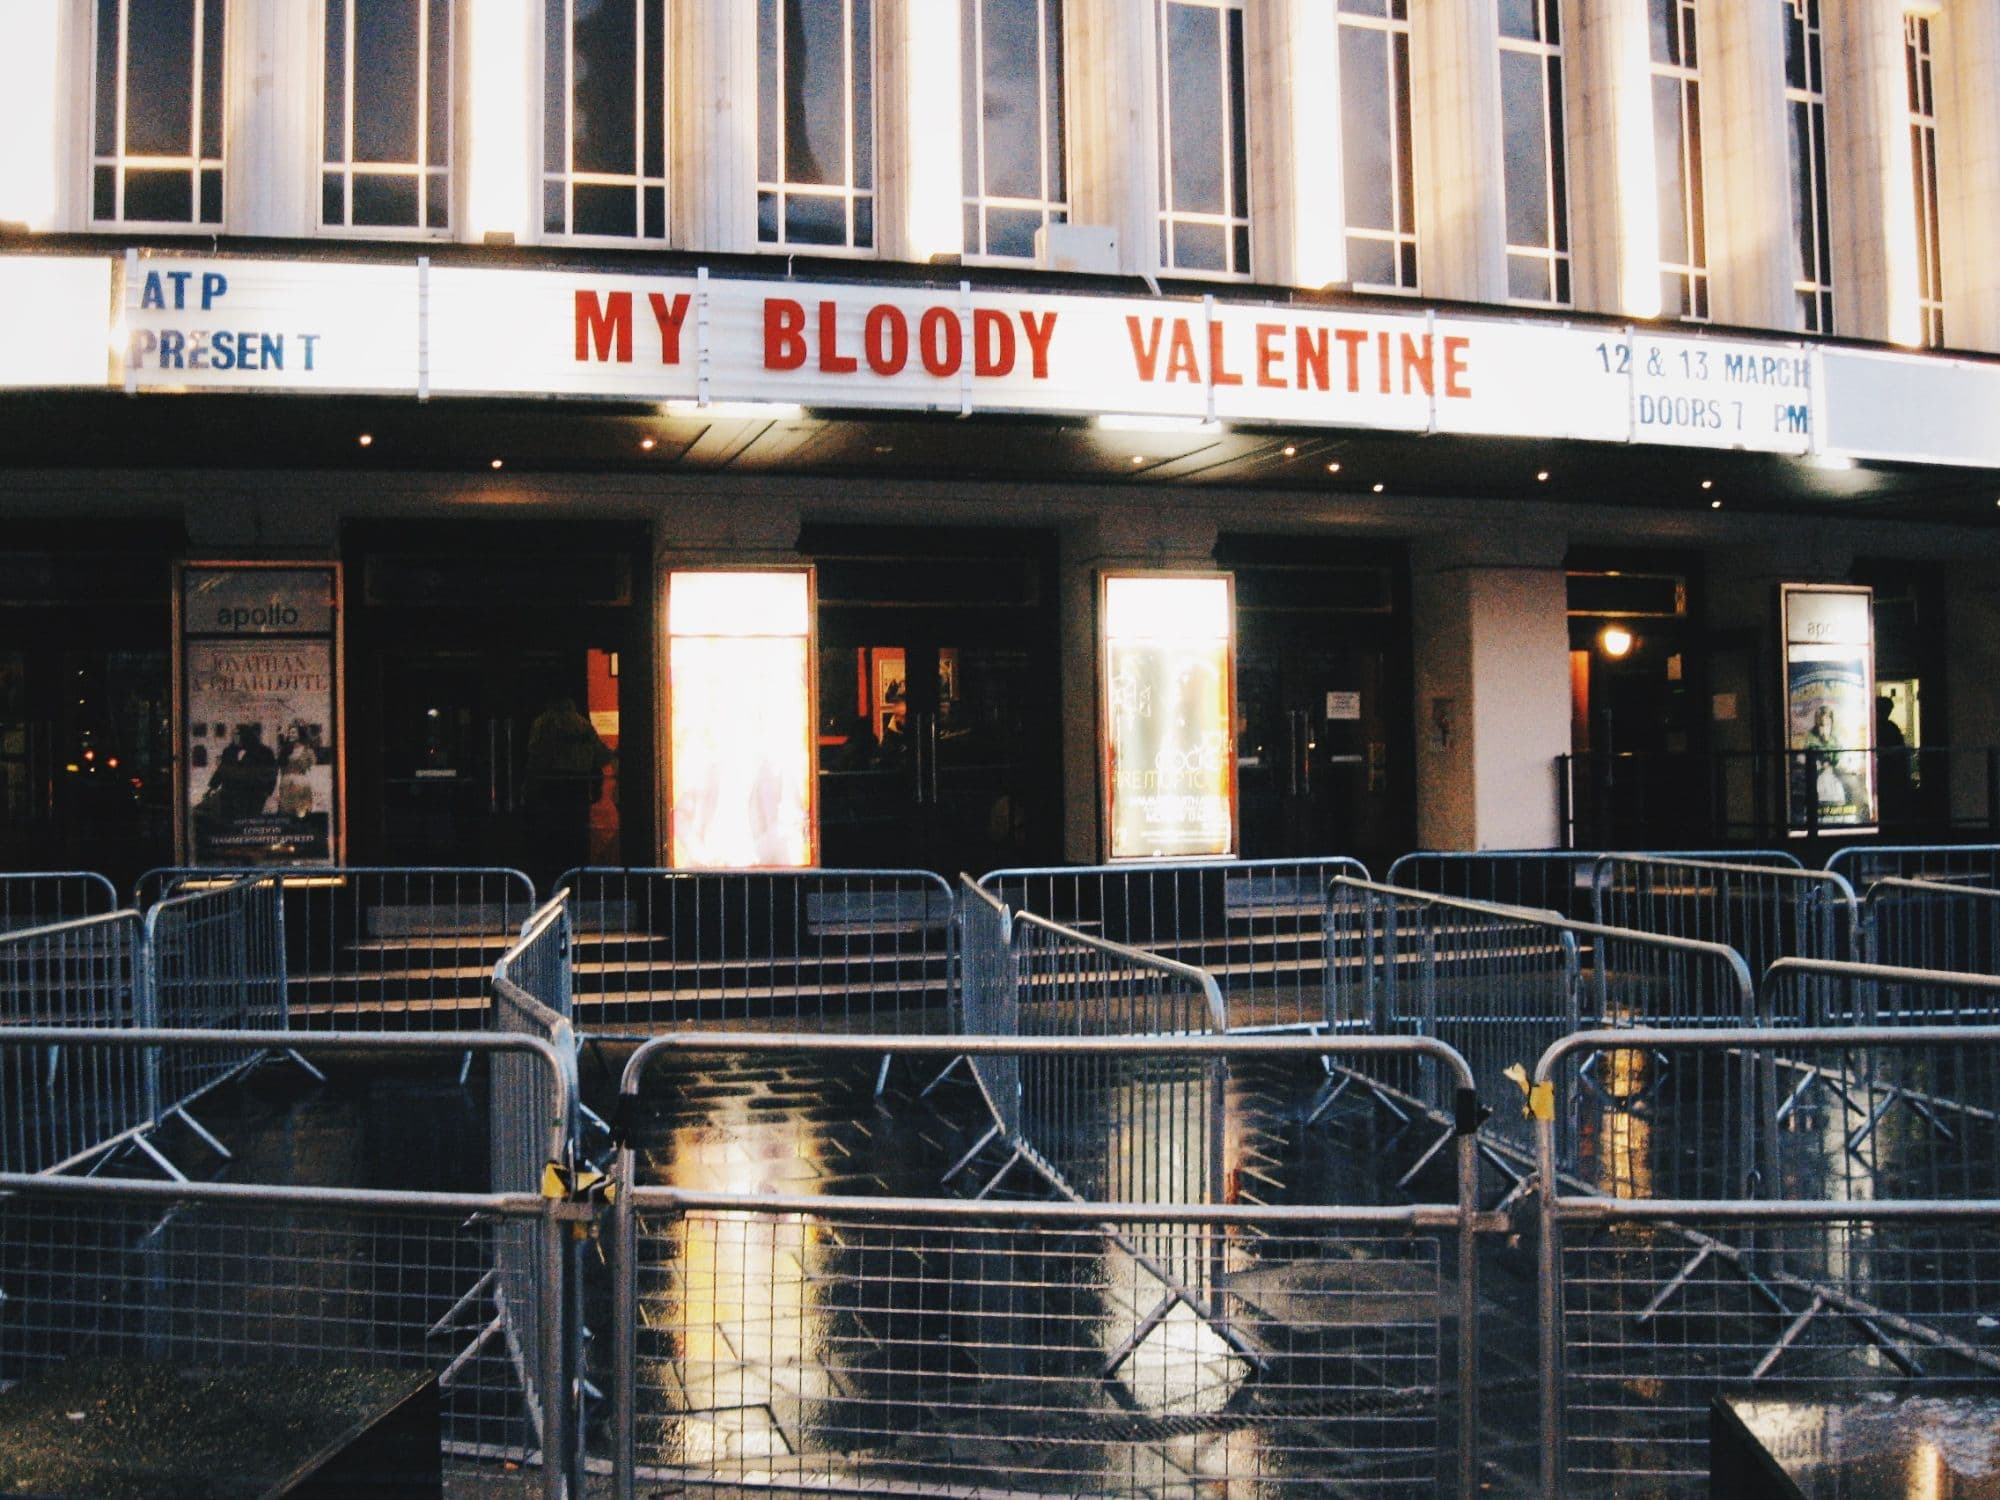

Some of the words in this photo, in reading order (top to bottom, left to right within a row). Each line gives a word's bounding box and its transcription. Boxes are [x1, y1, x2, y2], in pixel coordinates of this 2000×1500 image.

[141, 270, 228, 311] ATP
[574, 289, 692, 364] MY
[763, 297, 1058, 380] BLOODY
[1125, 314, 1473, 398] VALENTINE
[1596, 342, 1632, 375] 12
[1646, 346, 1666, 377] &
[1679, 349, 1709, 381] 13
[1723, 353, 1812, 388] MARCH
[1638, 394, 1722, 430] DOORS
[1729, 401, 1743, 431] 7
[1774, 404, 1809, 434] PM
[217, 602, 299, 629] apollo
